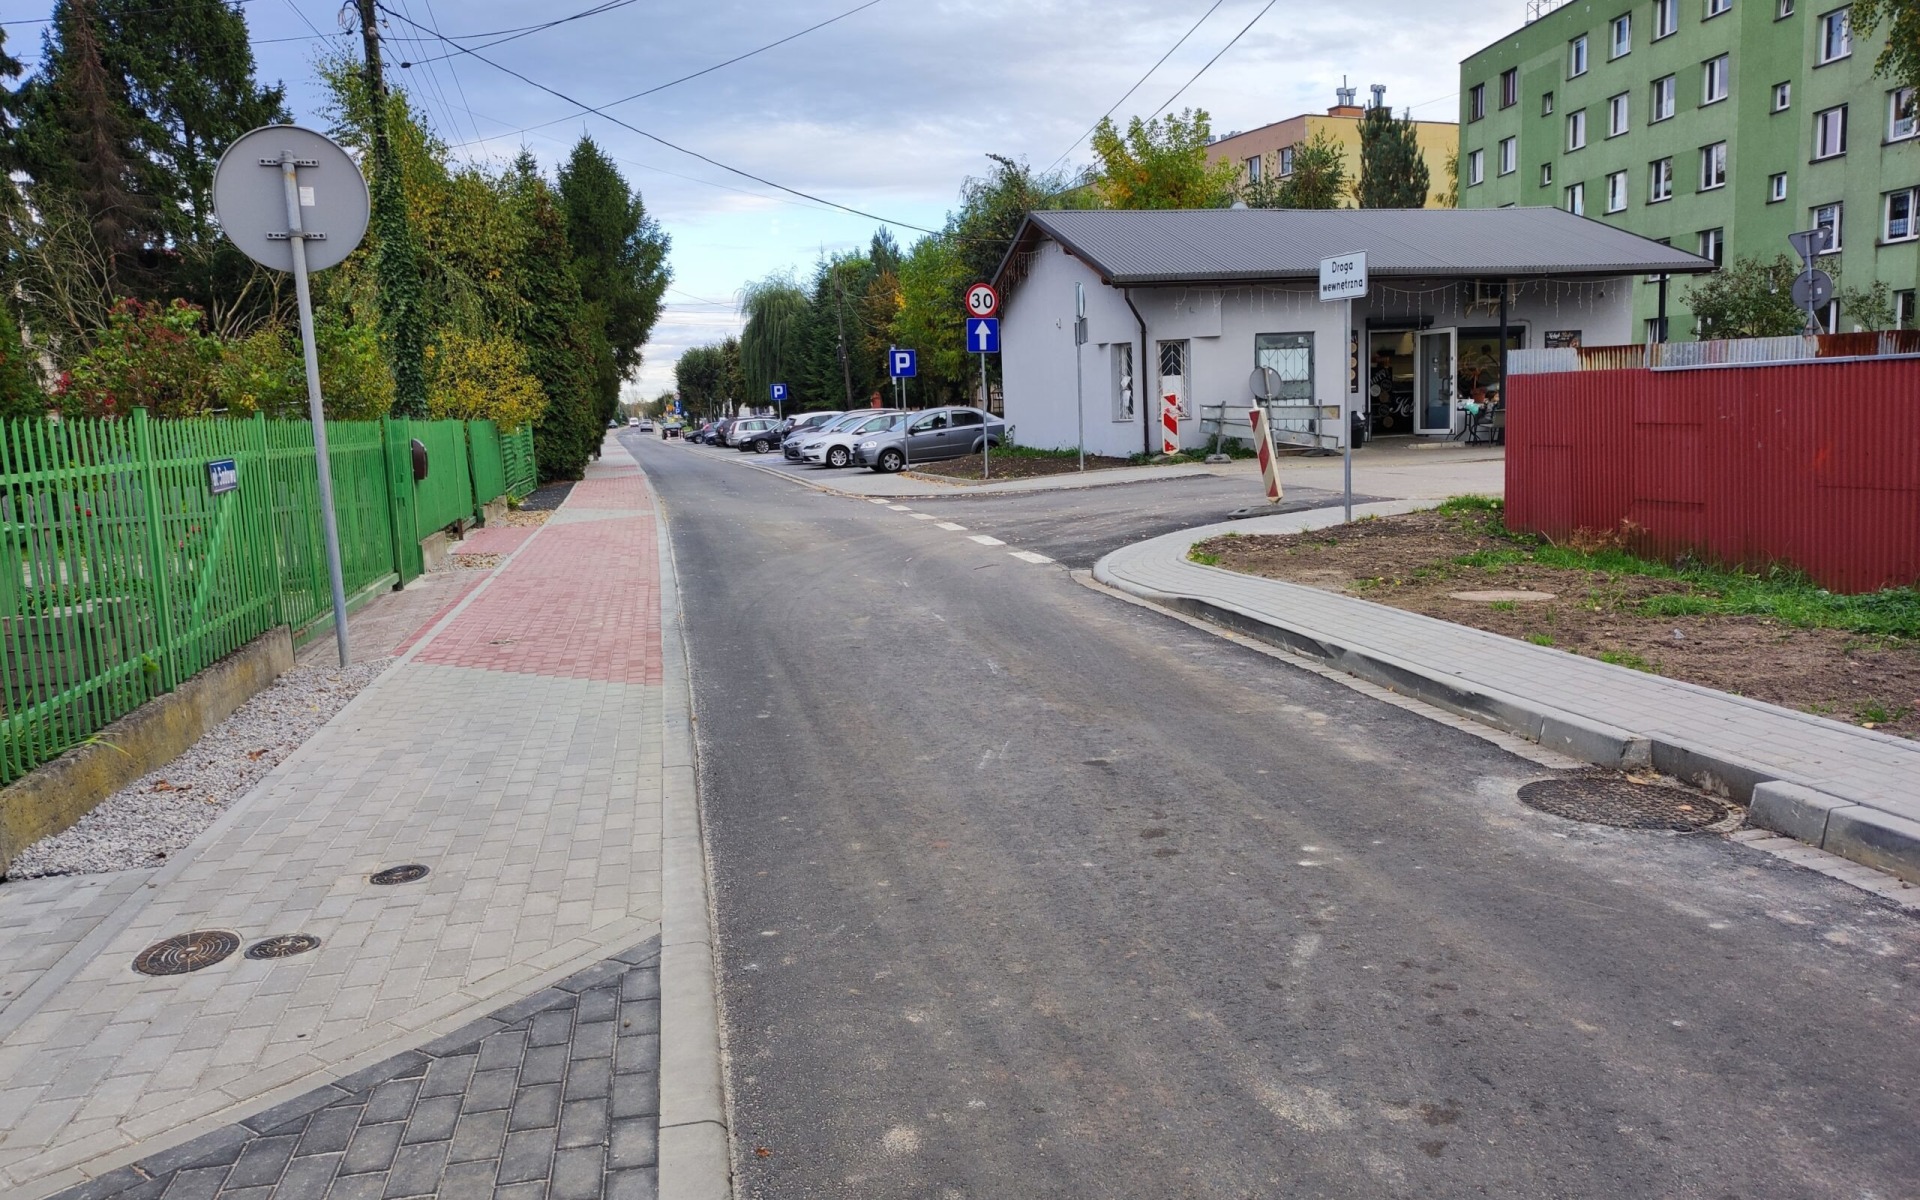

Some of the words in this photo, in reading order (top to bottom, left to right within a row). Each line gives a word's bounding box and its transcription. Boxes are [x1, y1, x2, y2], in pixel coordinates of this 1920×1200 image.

[1331, 261, 1354, 274] Droga
[1322, 278, 1363, 293] wewnętrzna
[971, 293, 993, 309] 30
[895, 353, 910, 374] P
[773, 385, 784, 398] P
